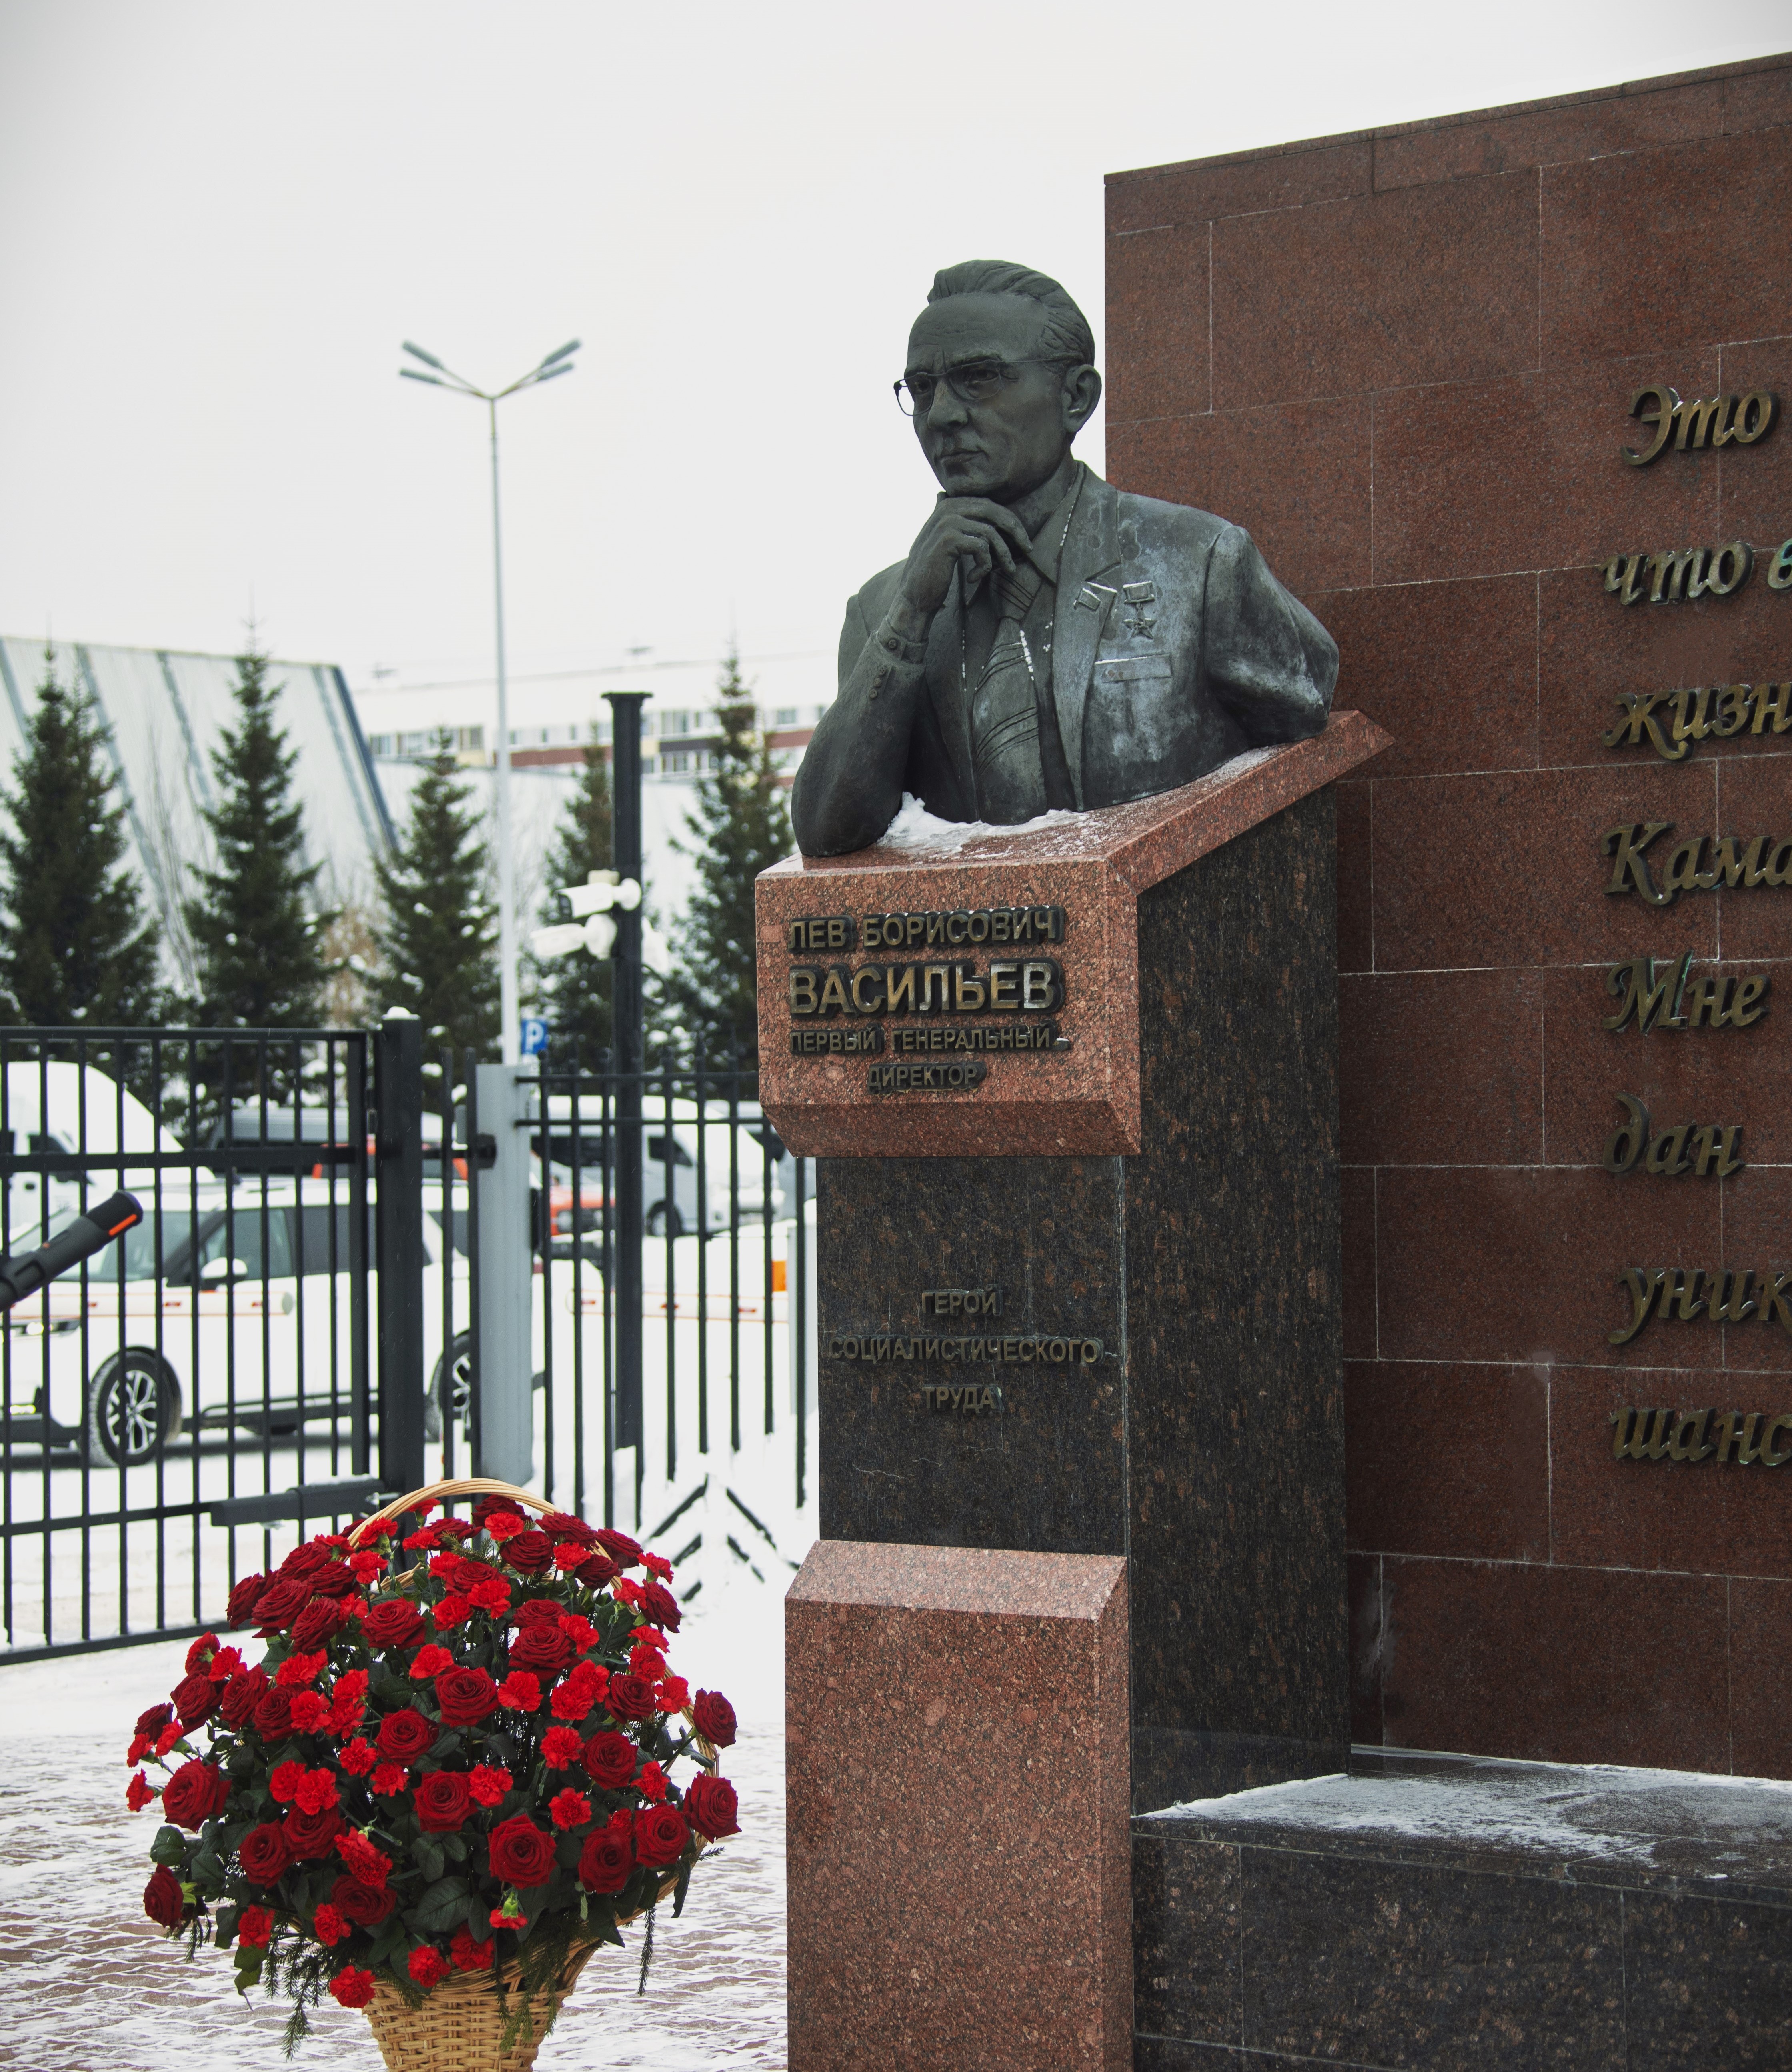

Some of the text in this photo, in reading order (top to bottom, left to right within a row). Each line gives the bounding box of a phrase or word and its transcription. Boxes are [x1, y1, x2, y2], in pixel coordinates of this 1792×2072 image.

[1620, 383, 1776, 466] Это
[1603, 542, 1749, 605] что
[1604, 681, 1792, 760] жизн
[788, 910, 1057, 950] ЛЕВ БОРИСОВИЧ
[789, 962, 1056, 1015] ВАСИЛЬЕВ
[1603, 950, 1768, 1034] Мне
[526, 1022, 544, 1051] P
[790, 1025, 878, 1052] ПЕРВЫЙ
[868, 1064, 979, 1092] ДИРЕКТОР
[1603, 1094, 1744, 1176] дан
[921, 1286, 997, 1315] ГЕРОЙ
[1608, 1267, 1792, 1344] уник
[828, 1338, 1099, 1364] СОЦИАЛИСТИЧЕСКОГО
[922, 1386, 997, 1413] ТРУДА
[1608, 1406, 1792, 1466] шанс
